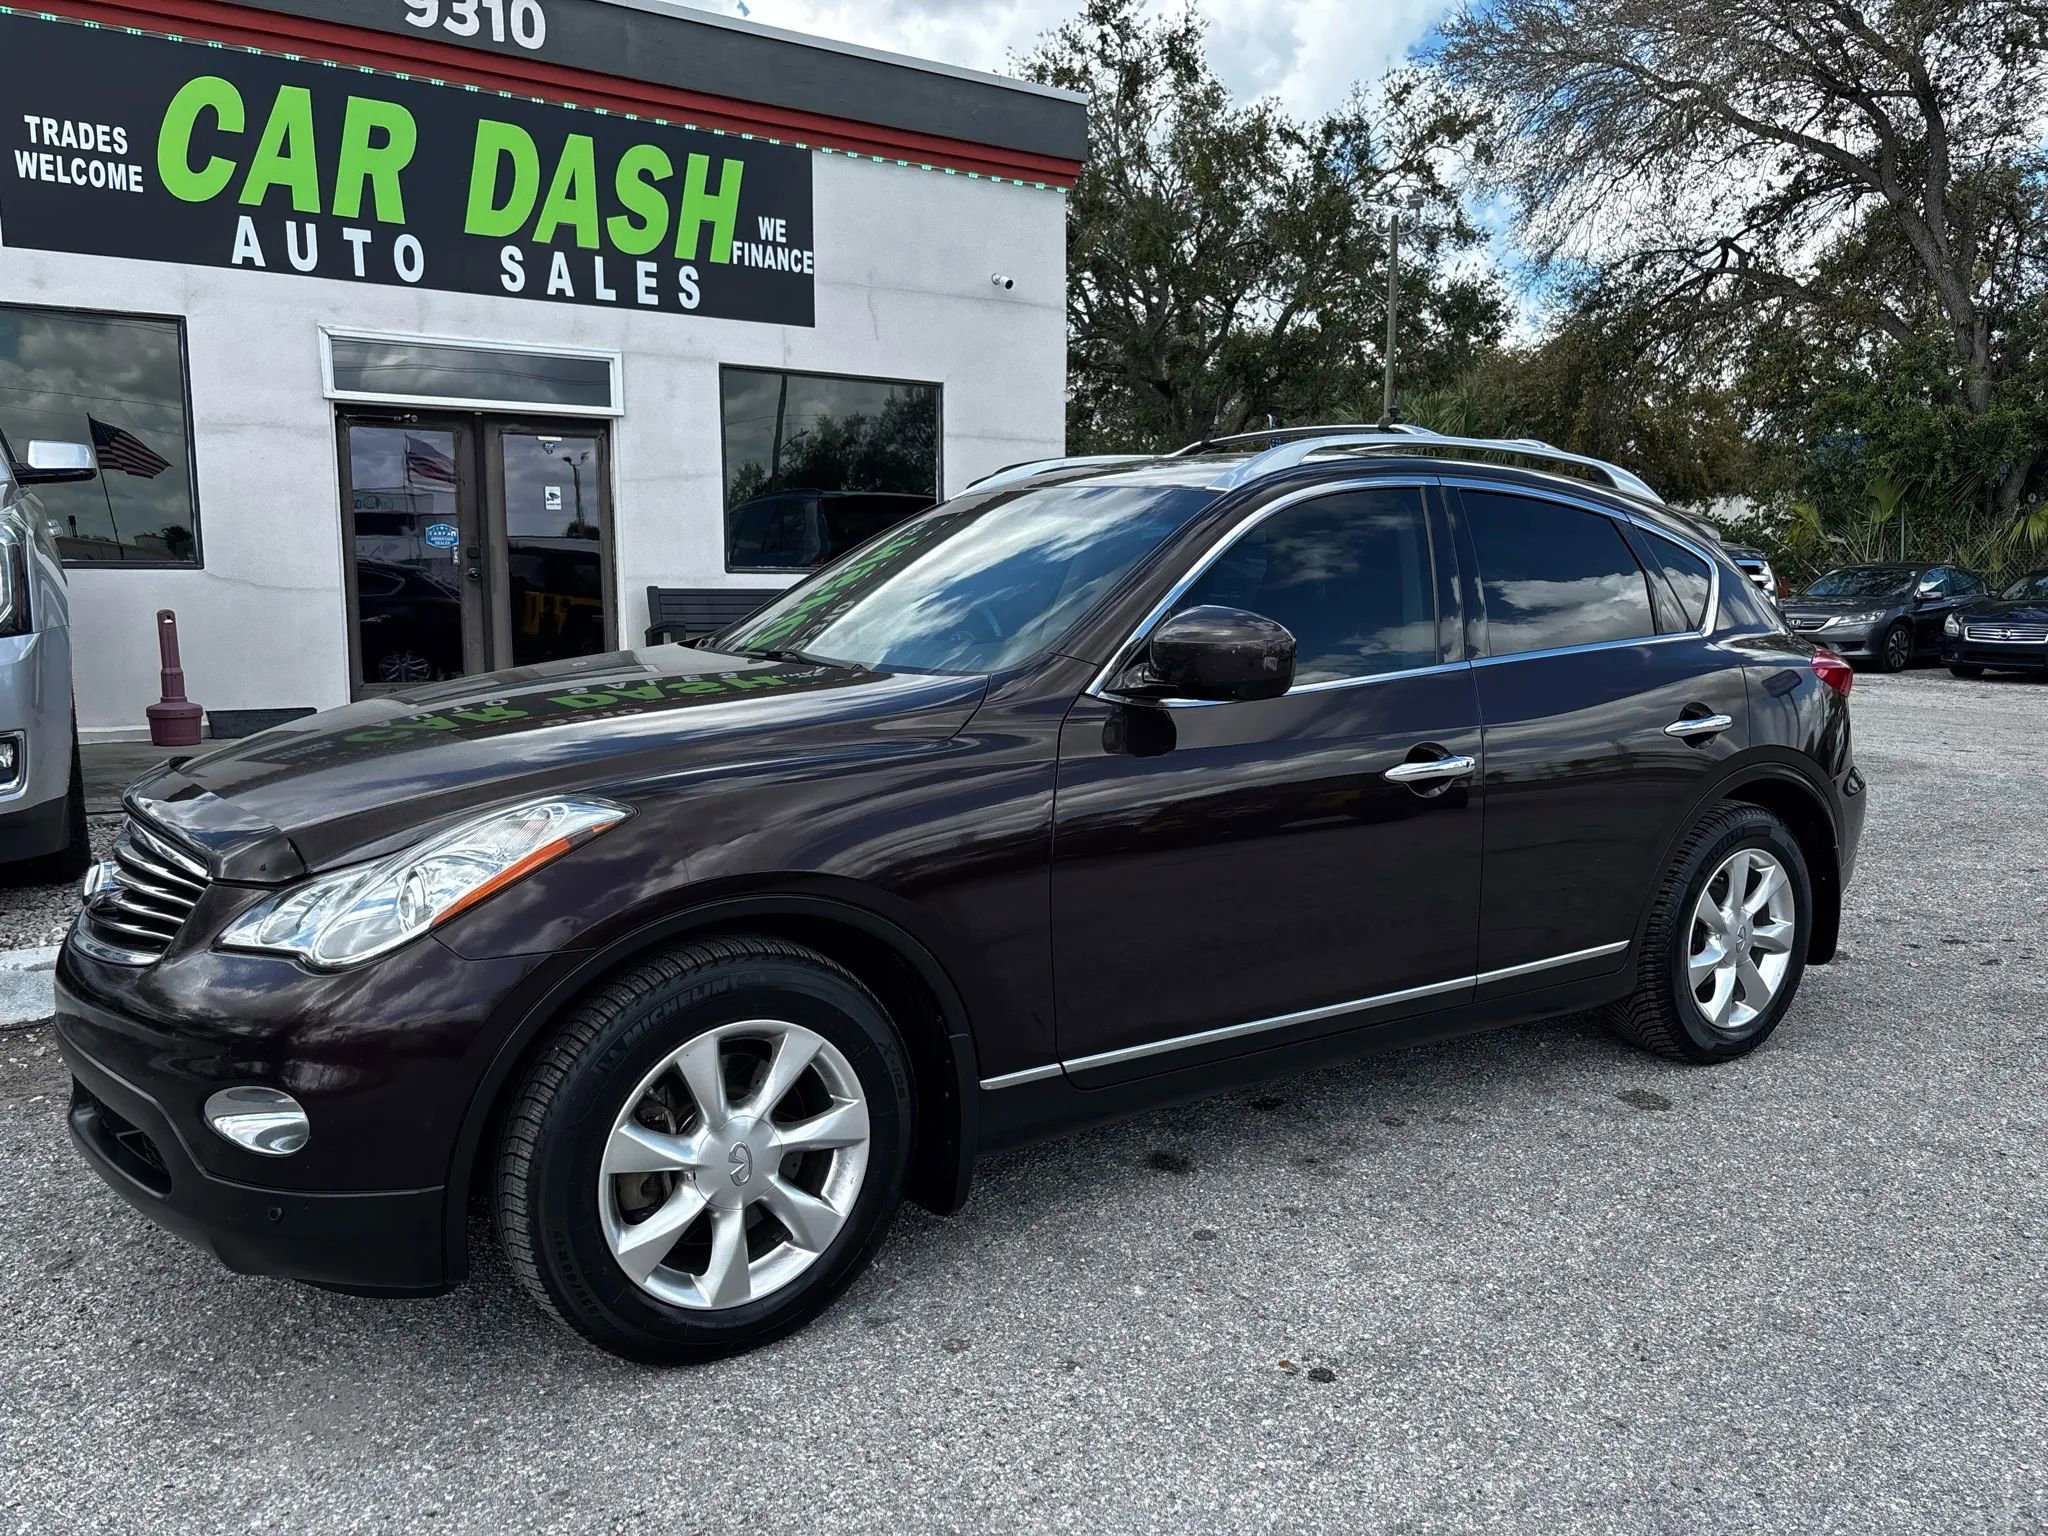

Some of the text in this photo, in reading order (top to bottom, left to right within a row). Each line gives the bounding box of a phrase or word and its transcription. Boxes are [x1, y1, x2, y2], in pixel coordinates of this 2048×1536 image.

[23, 114, 129, 155] TRADES
[14, 149, 144, 193] WELCOME
[157, 75, 744, 265] CAR DASH
[757, 215, 788, 243] WE
[231, 215, 701, 310] AUTO SALES
[732, 240, 814, 275] FINANCE
[623, 974, 731, 1049] MICHELIN
